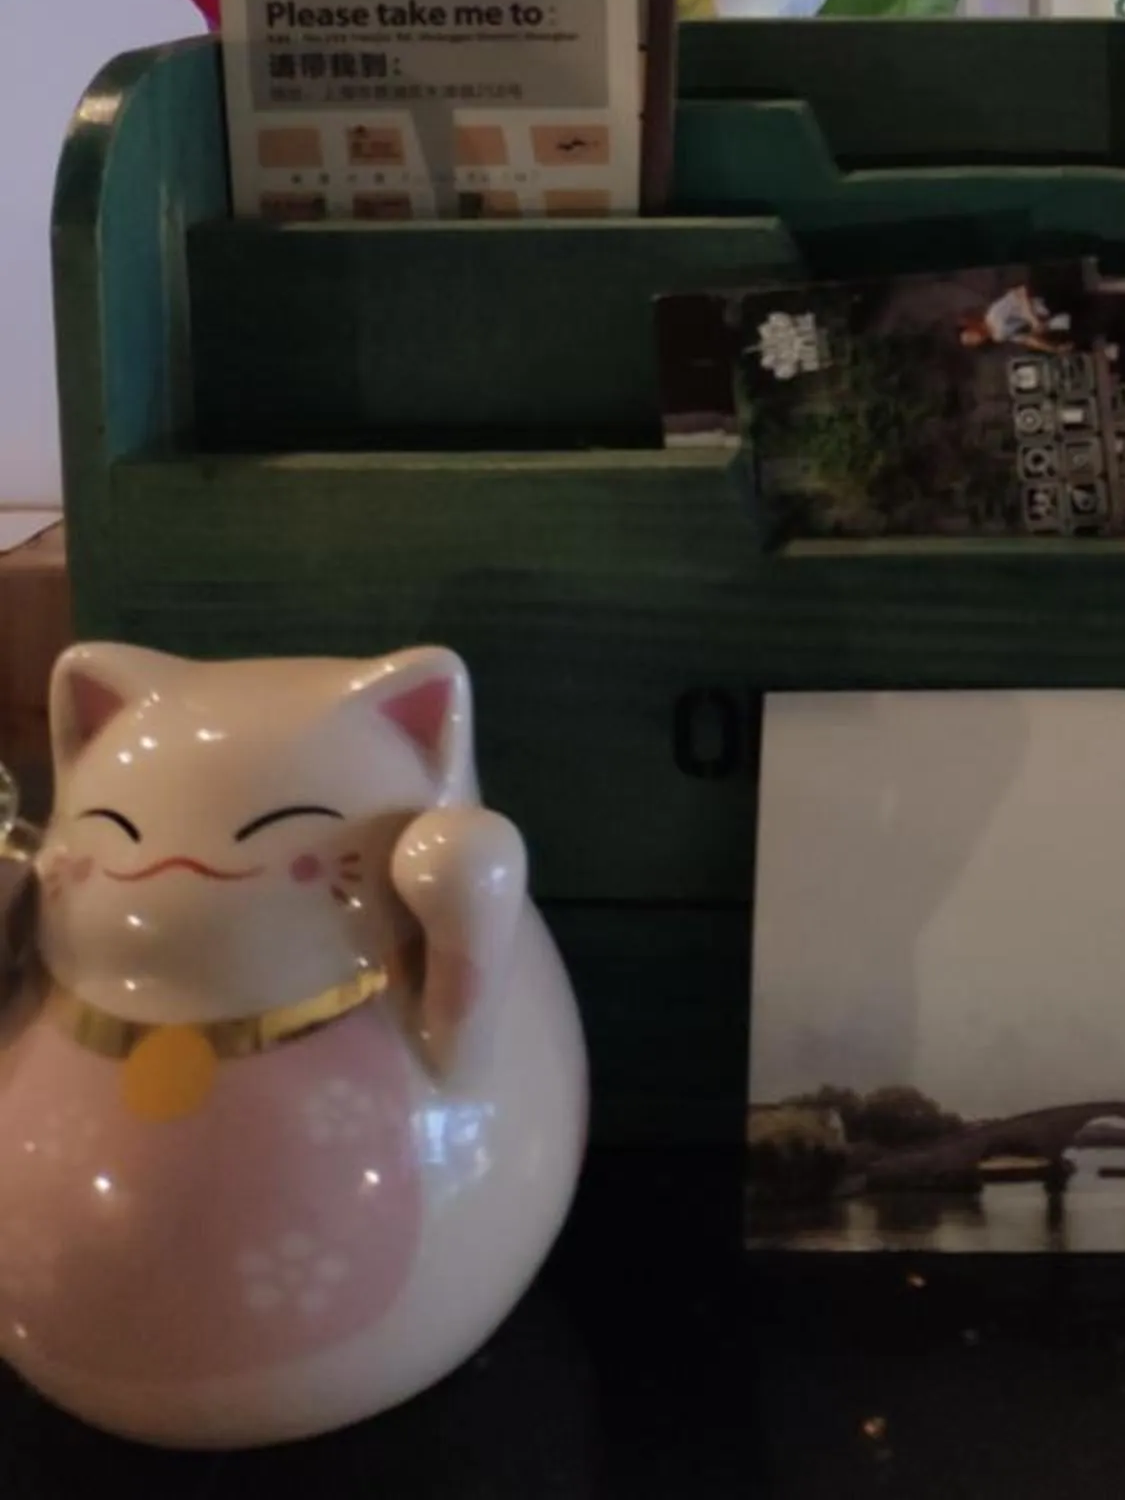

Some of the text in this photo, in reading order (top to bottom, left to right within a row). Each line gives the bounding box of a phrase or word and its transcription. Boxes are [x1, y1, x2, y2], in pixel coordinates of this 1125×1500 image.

[266, 1, 369, 28] Please
[376, 0, 447, 27] take
[454, 4, 503, 26] me
